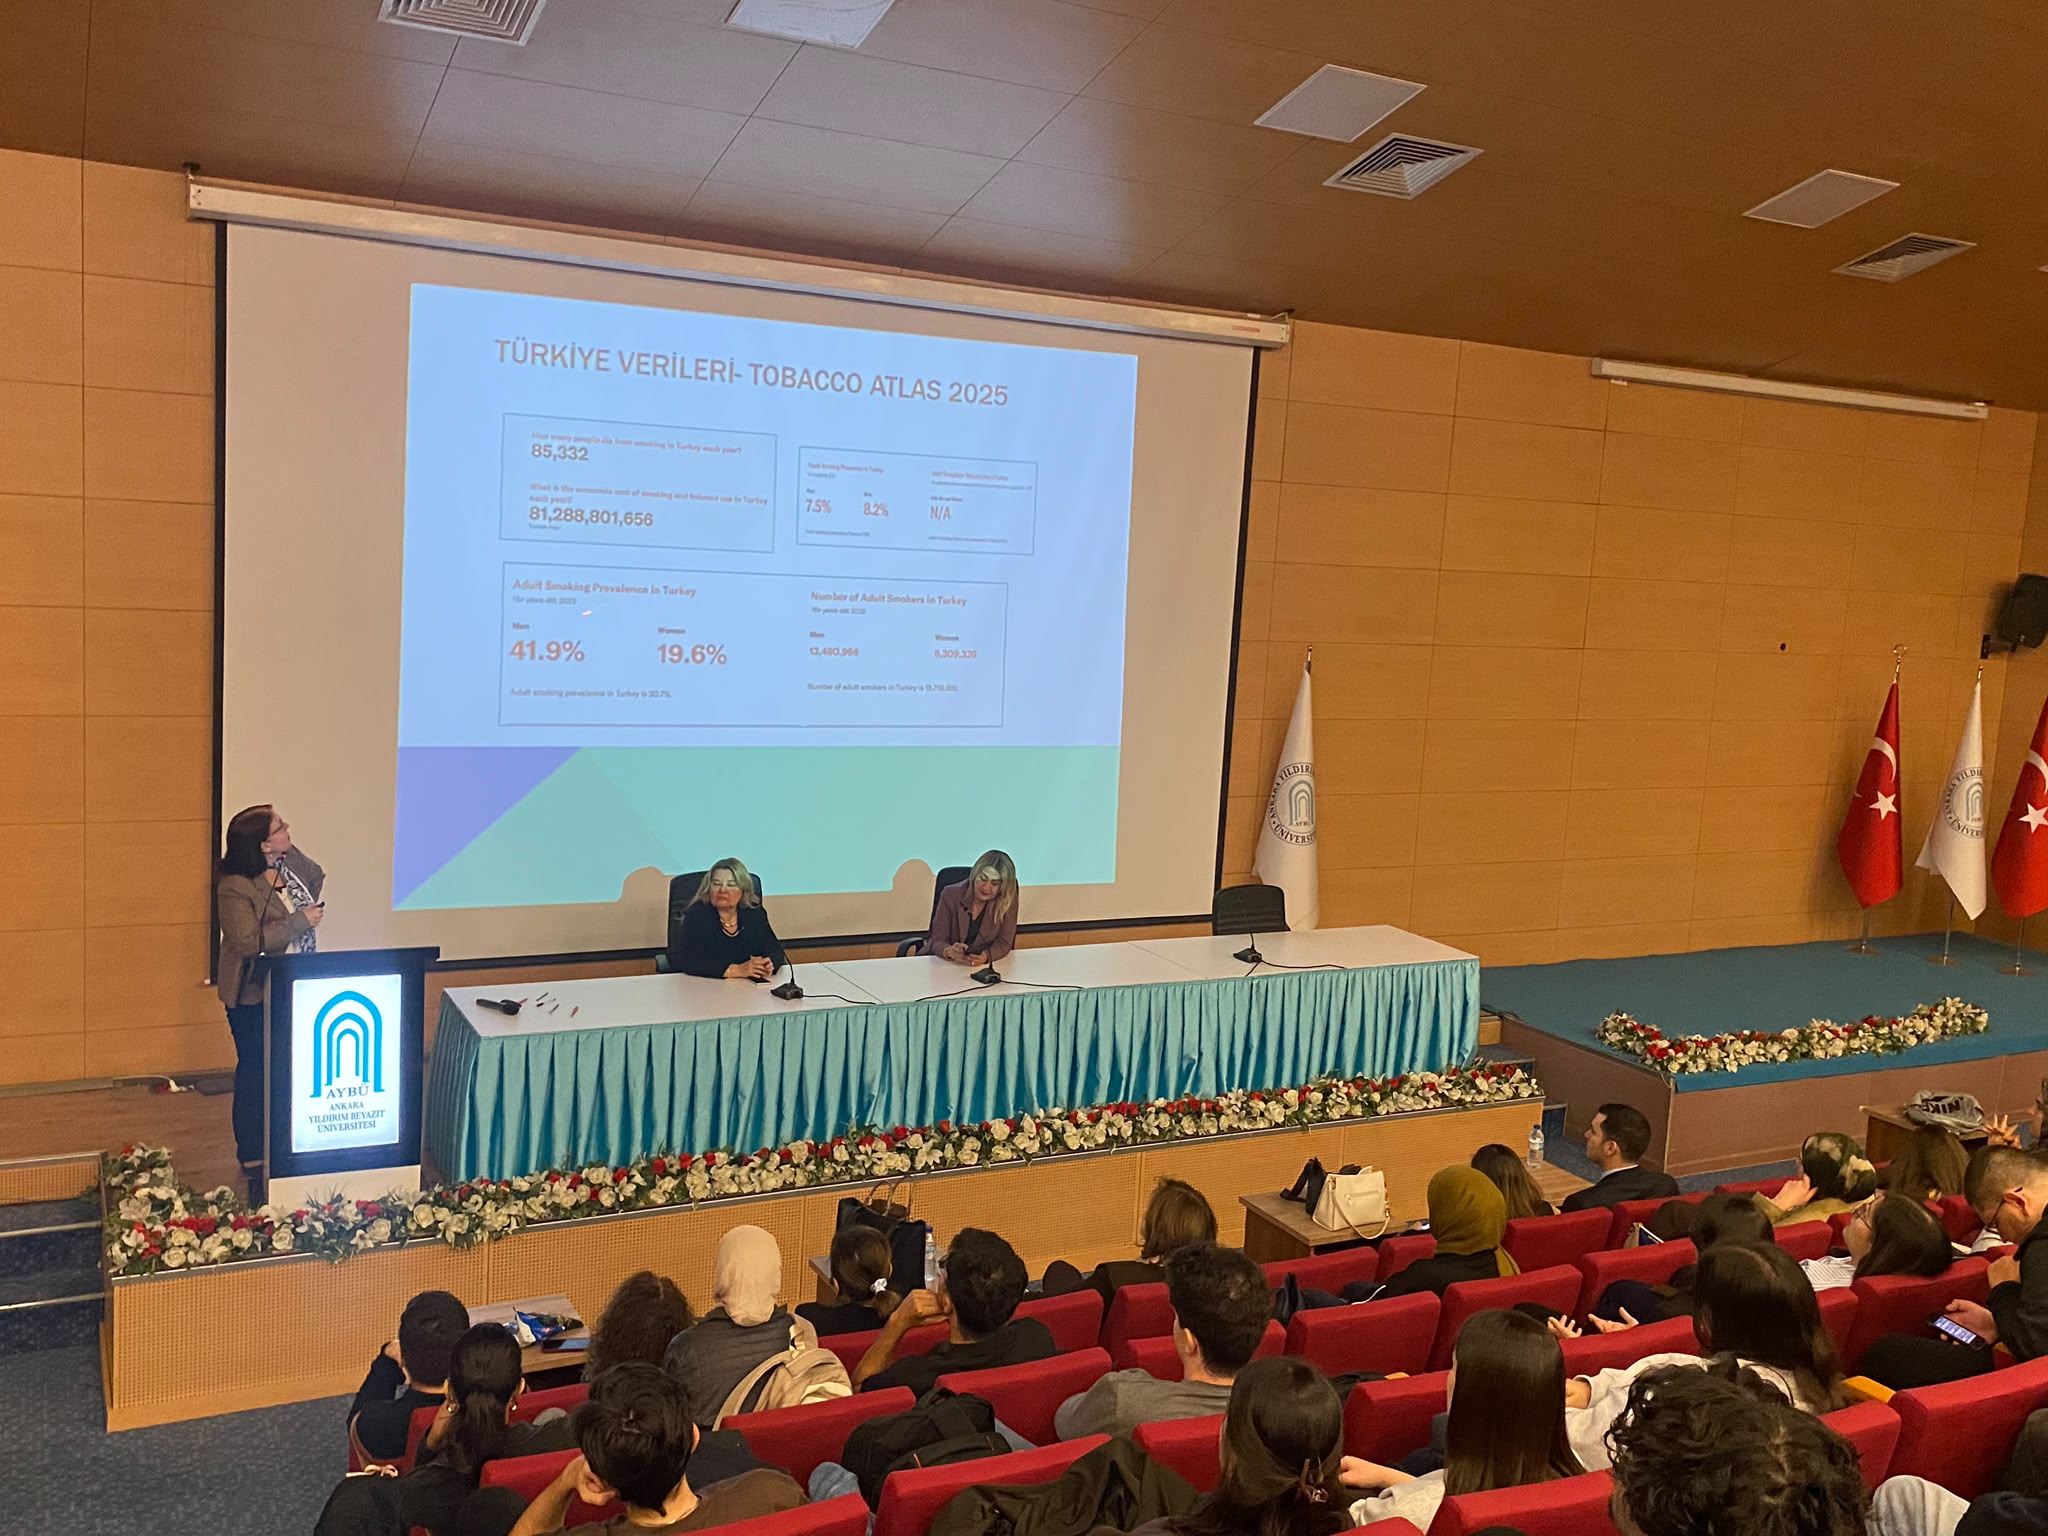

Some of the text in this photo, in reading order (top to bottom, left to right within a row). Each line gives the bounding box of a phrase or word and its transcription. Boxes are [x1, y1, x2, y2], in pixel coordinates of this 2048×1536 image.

[495, 336, 1008, 406] TÜRKİYE VERİLERİ- TOBACCO ATLAS 2025
[531, 444, 589, 461] 85,332
[806, 498, 832, 514] 7.5%
[863, 502, 889, 518] 8.2%
[930, 505, 951, 520] N/A
[529, 506, 653, 527] 81,288,801,656
[512, 579, 697, 598] Adult Smoking Prevalence in Turkey
[811, 591, 967, 607] Number of Adult Smokers in Turkey
[512, 621, 530, 630] Men
[657, 626, 686, 635] Women
[510, 639, 585, 662] 41.9%
[657, 643, 728, 665] 19.6%
[326, 1083, 369, 1099] AYBÜ
[329, 1101, 364, 1112] ANKARA
[309, 1109, 386, 1124] YILDIRIM BEYAZIT
[317, 1119, 376, 1133] ÜNİVERSİTESİ
